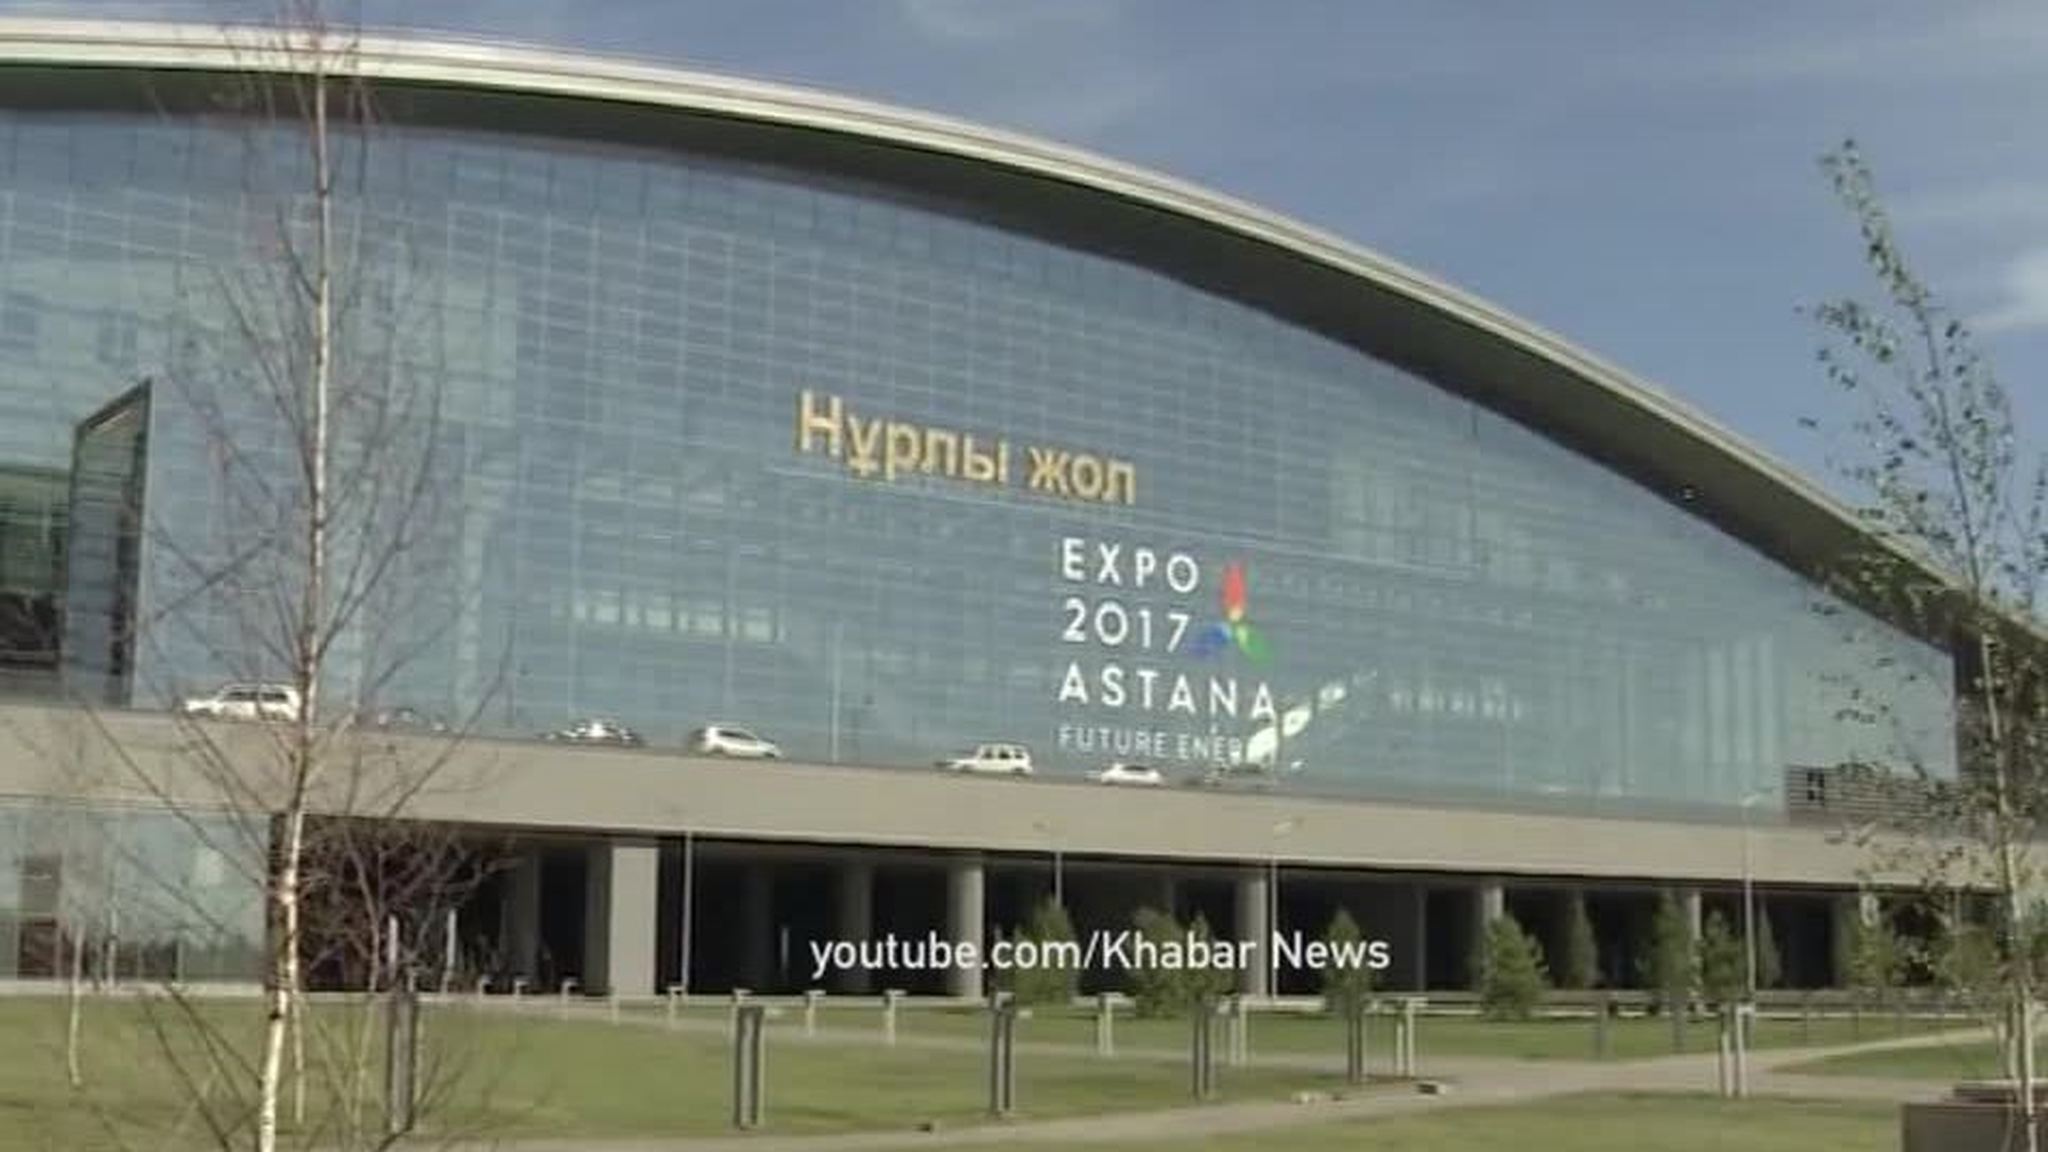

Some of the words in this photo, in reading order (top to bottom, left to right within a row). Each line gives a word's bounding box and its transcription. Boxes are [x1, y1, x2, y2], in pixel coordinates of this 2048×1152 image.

[797, 388, 1010, 481] Нұрлы
[1029, 445, 1136, 504] жол
[1062, 537, 1199, 593] EXPO
[1062, 597, 1190, 652] 2017
[1058, 661, 1277, 719] ASTANA
[1058, 725, 1168, 759] FUTURE
[1177, 732, 1243, 765] ENER
